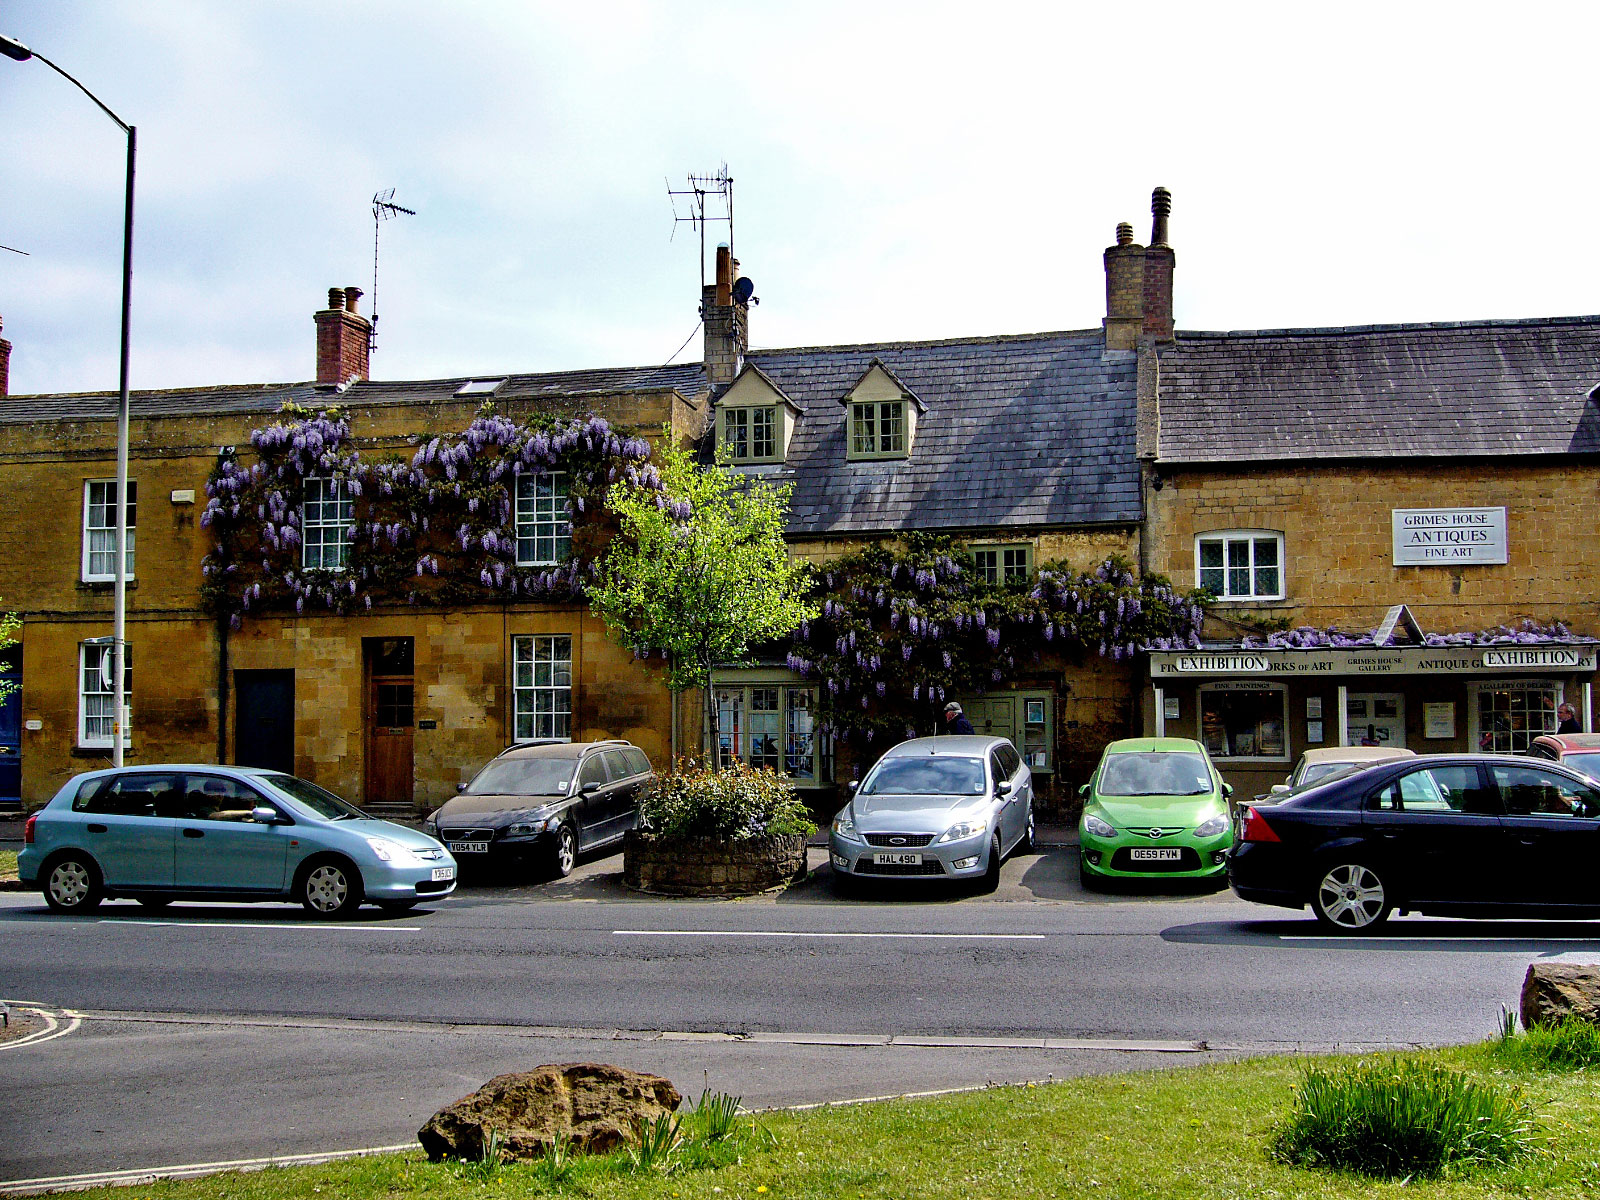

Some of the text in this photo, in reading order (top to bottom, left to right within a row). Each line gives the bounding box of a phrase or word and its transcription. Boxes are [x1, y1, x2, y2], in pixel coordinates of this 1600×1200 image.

[1404, 514, 1488, 525] GRIMES HOUSE
[1411, 530, 1487, 543] ANTIQUES
[1425, 547, 1473, 557] FINE ART
[1180, 656, 1265, 670] EXHIBITION
[1488, 650, 1575, 665] EXHIBITION
[1160, 663, 1179, 673] FIN
[1267, 662, 1296, 672] ORKS
[1311, 661, 1334, 671] ART
[1358, 664, 1392, 672] GALLERY
[1417, 659, 1469, 671] ANTIQUE
[471, 843, 486, 852] YLR
[879, 854, 916, 864] HAL 490
[1134, 850, 1158, 859] OE59
